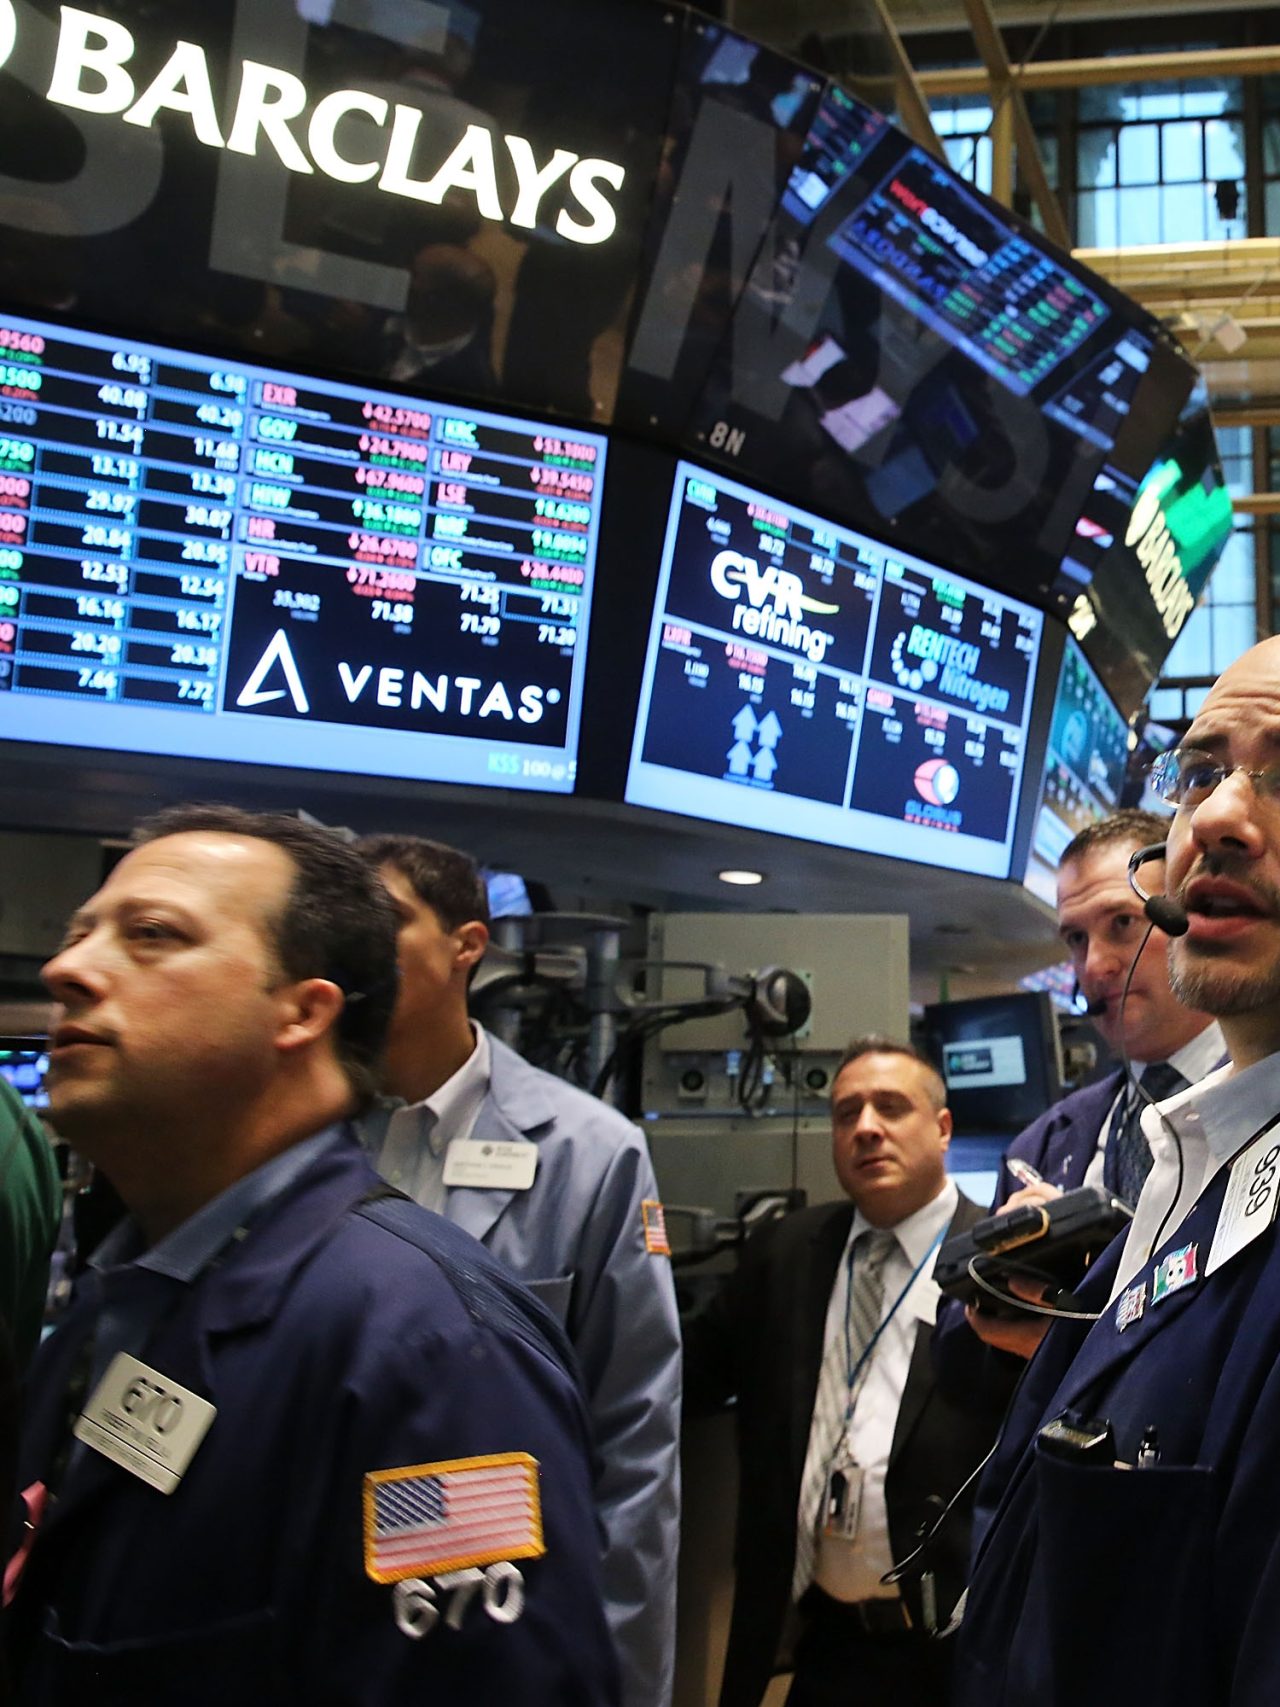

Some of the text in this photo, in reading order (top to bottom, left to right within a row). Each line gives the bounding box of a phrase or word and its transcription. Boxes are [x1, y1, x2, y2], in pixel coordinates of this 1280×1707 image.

[46, 5, 627, 245] BARCLAYS
[709, 421, 746, 456] 8N
[711, 549, 803, 621] CVR
[732, 603, 828, 663] refining
[338, 662, 545, 724] VENTAS
[937, 663, 1011, 713] Nitrogen
[118, 1375, 186, 1438] 670
[393, 1560, 525, 1640] 670
